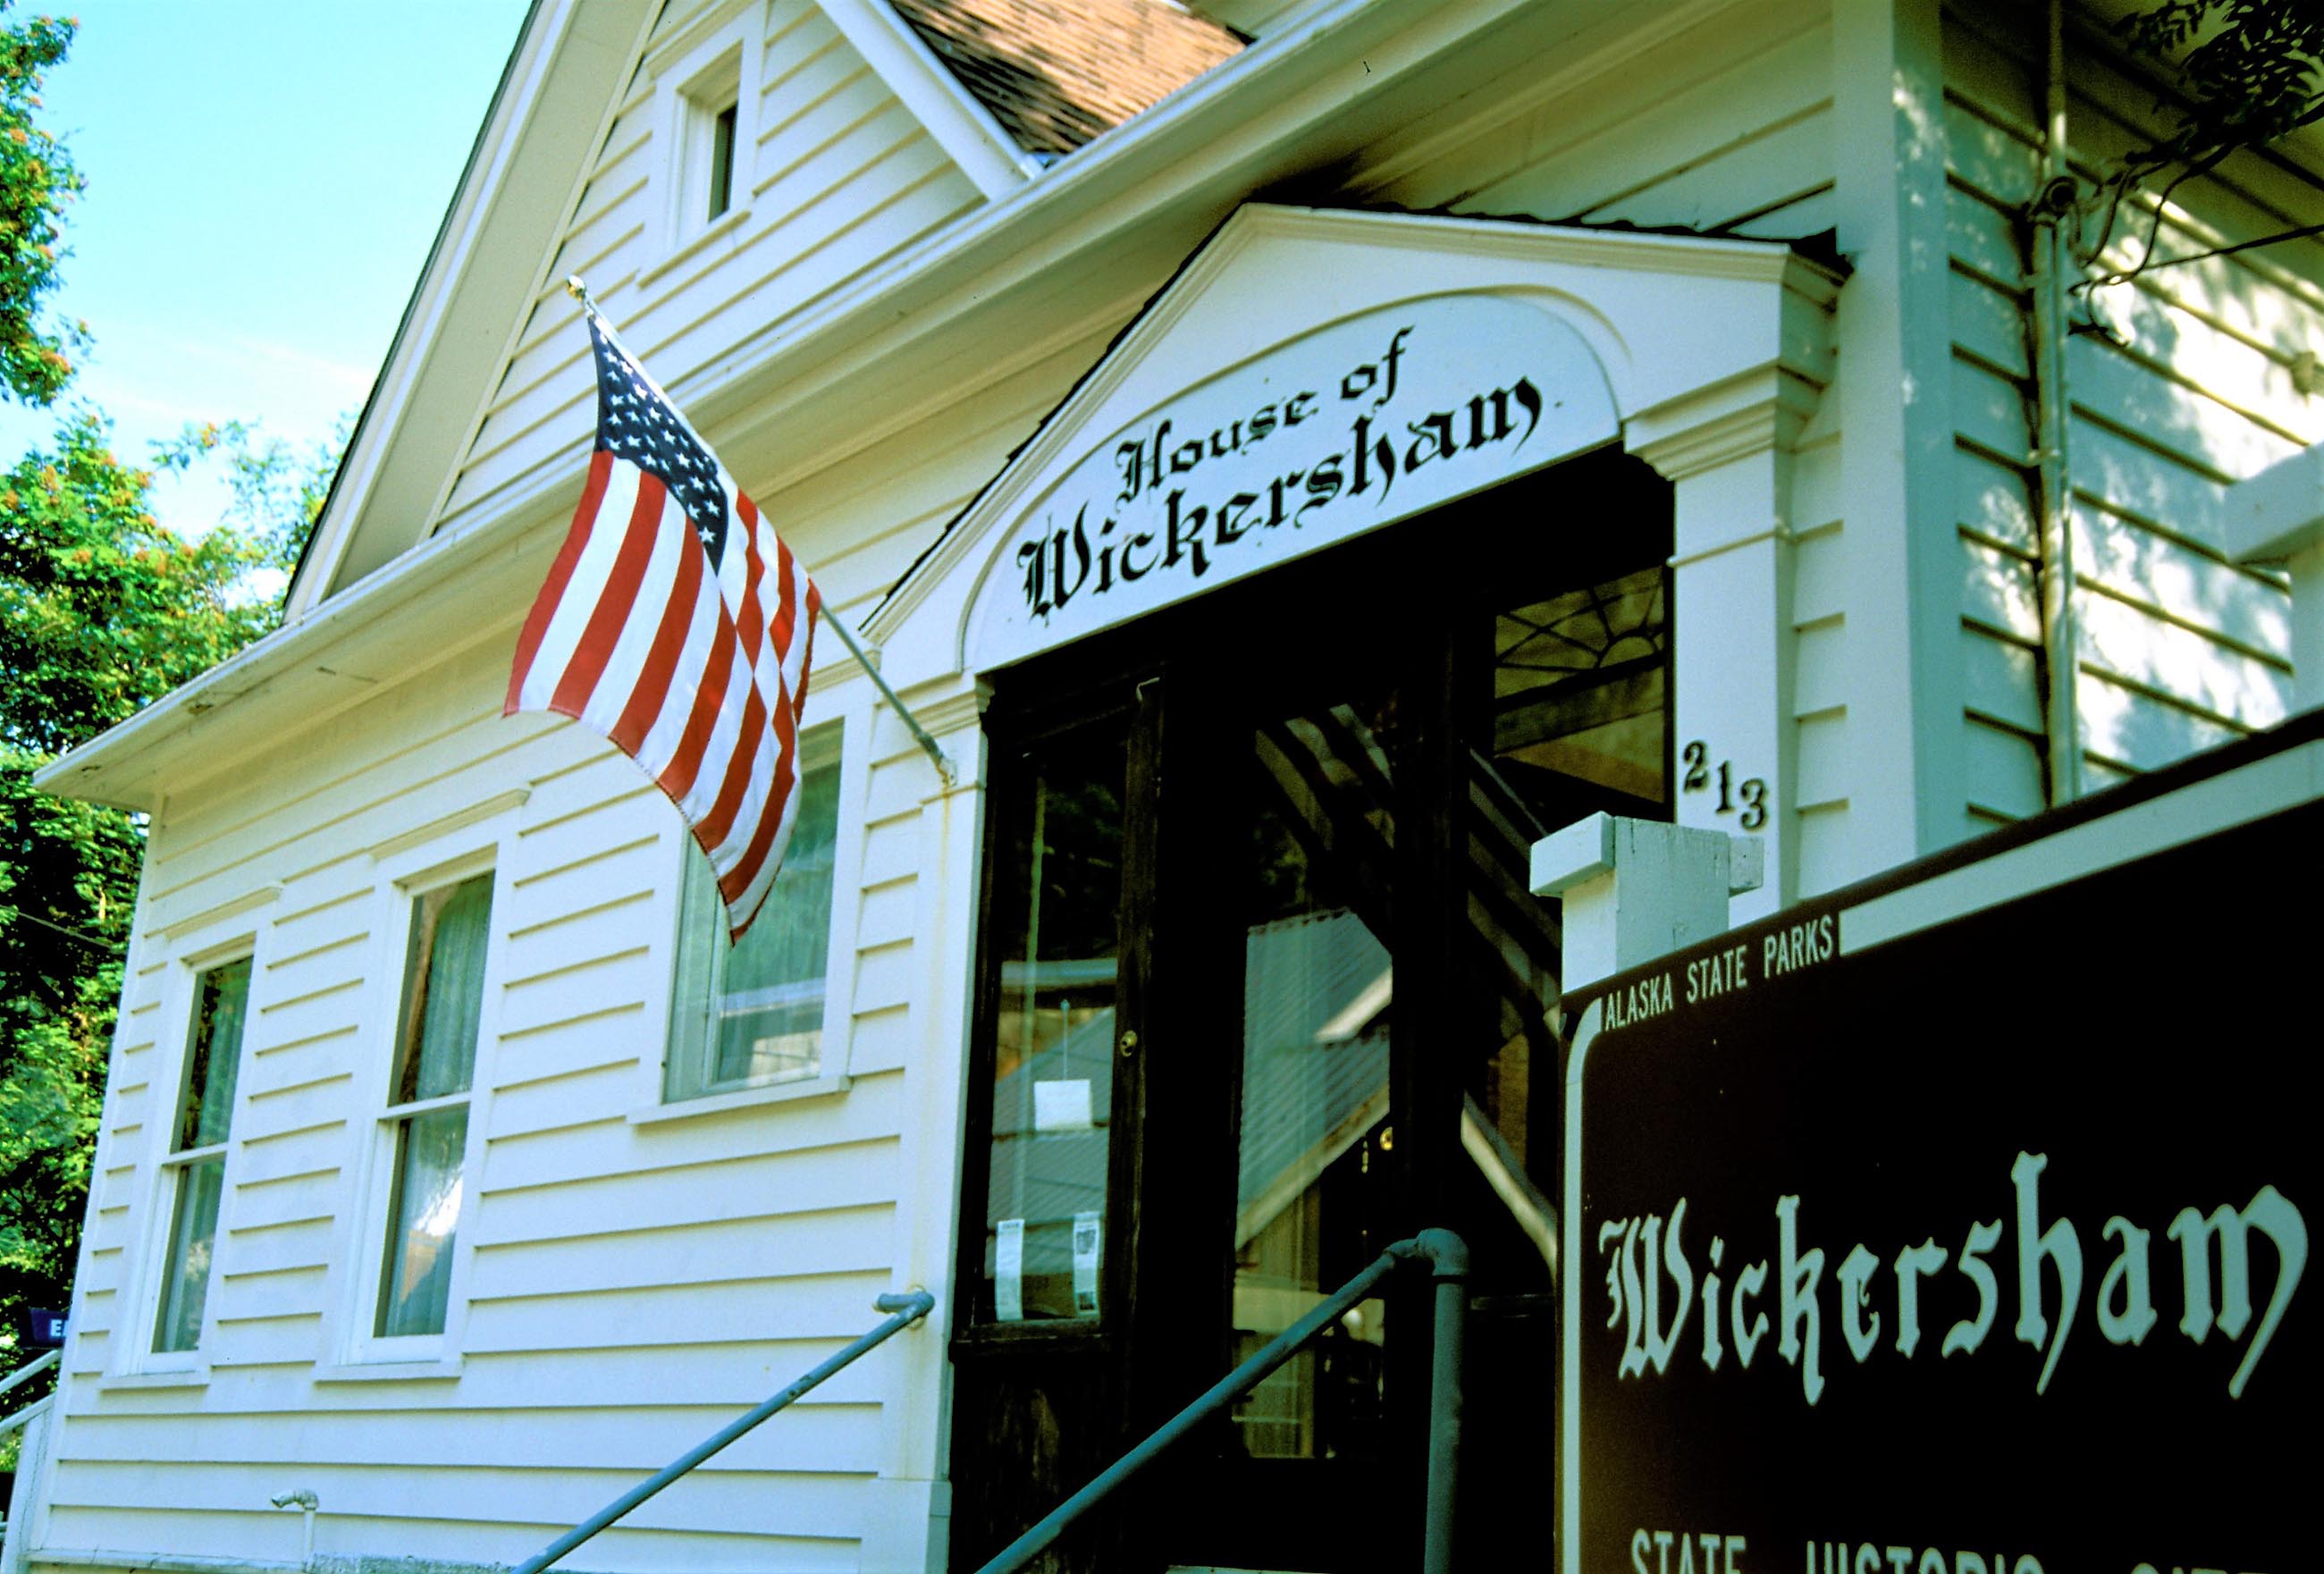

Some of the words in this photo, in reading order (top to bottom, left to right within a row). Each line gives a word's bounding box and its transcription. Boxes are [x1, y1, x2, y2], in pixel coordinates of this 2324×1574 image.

[1016, 375, 1543, 627] Wickersham
[1115, 391, 1318, 503] House
[1340, 325, 1414, 408] of
[1683, 740, 1768, 831] 213
[1604, 972, 1674, 1031] ALASKA
[1686, 945, 1747, 1004] STATE
[1764, 914, 1833, 979] PARKS
[1598, 1150, 2309, 1406] Wickersham
